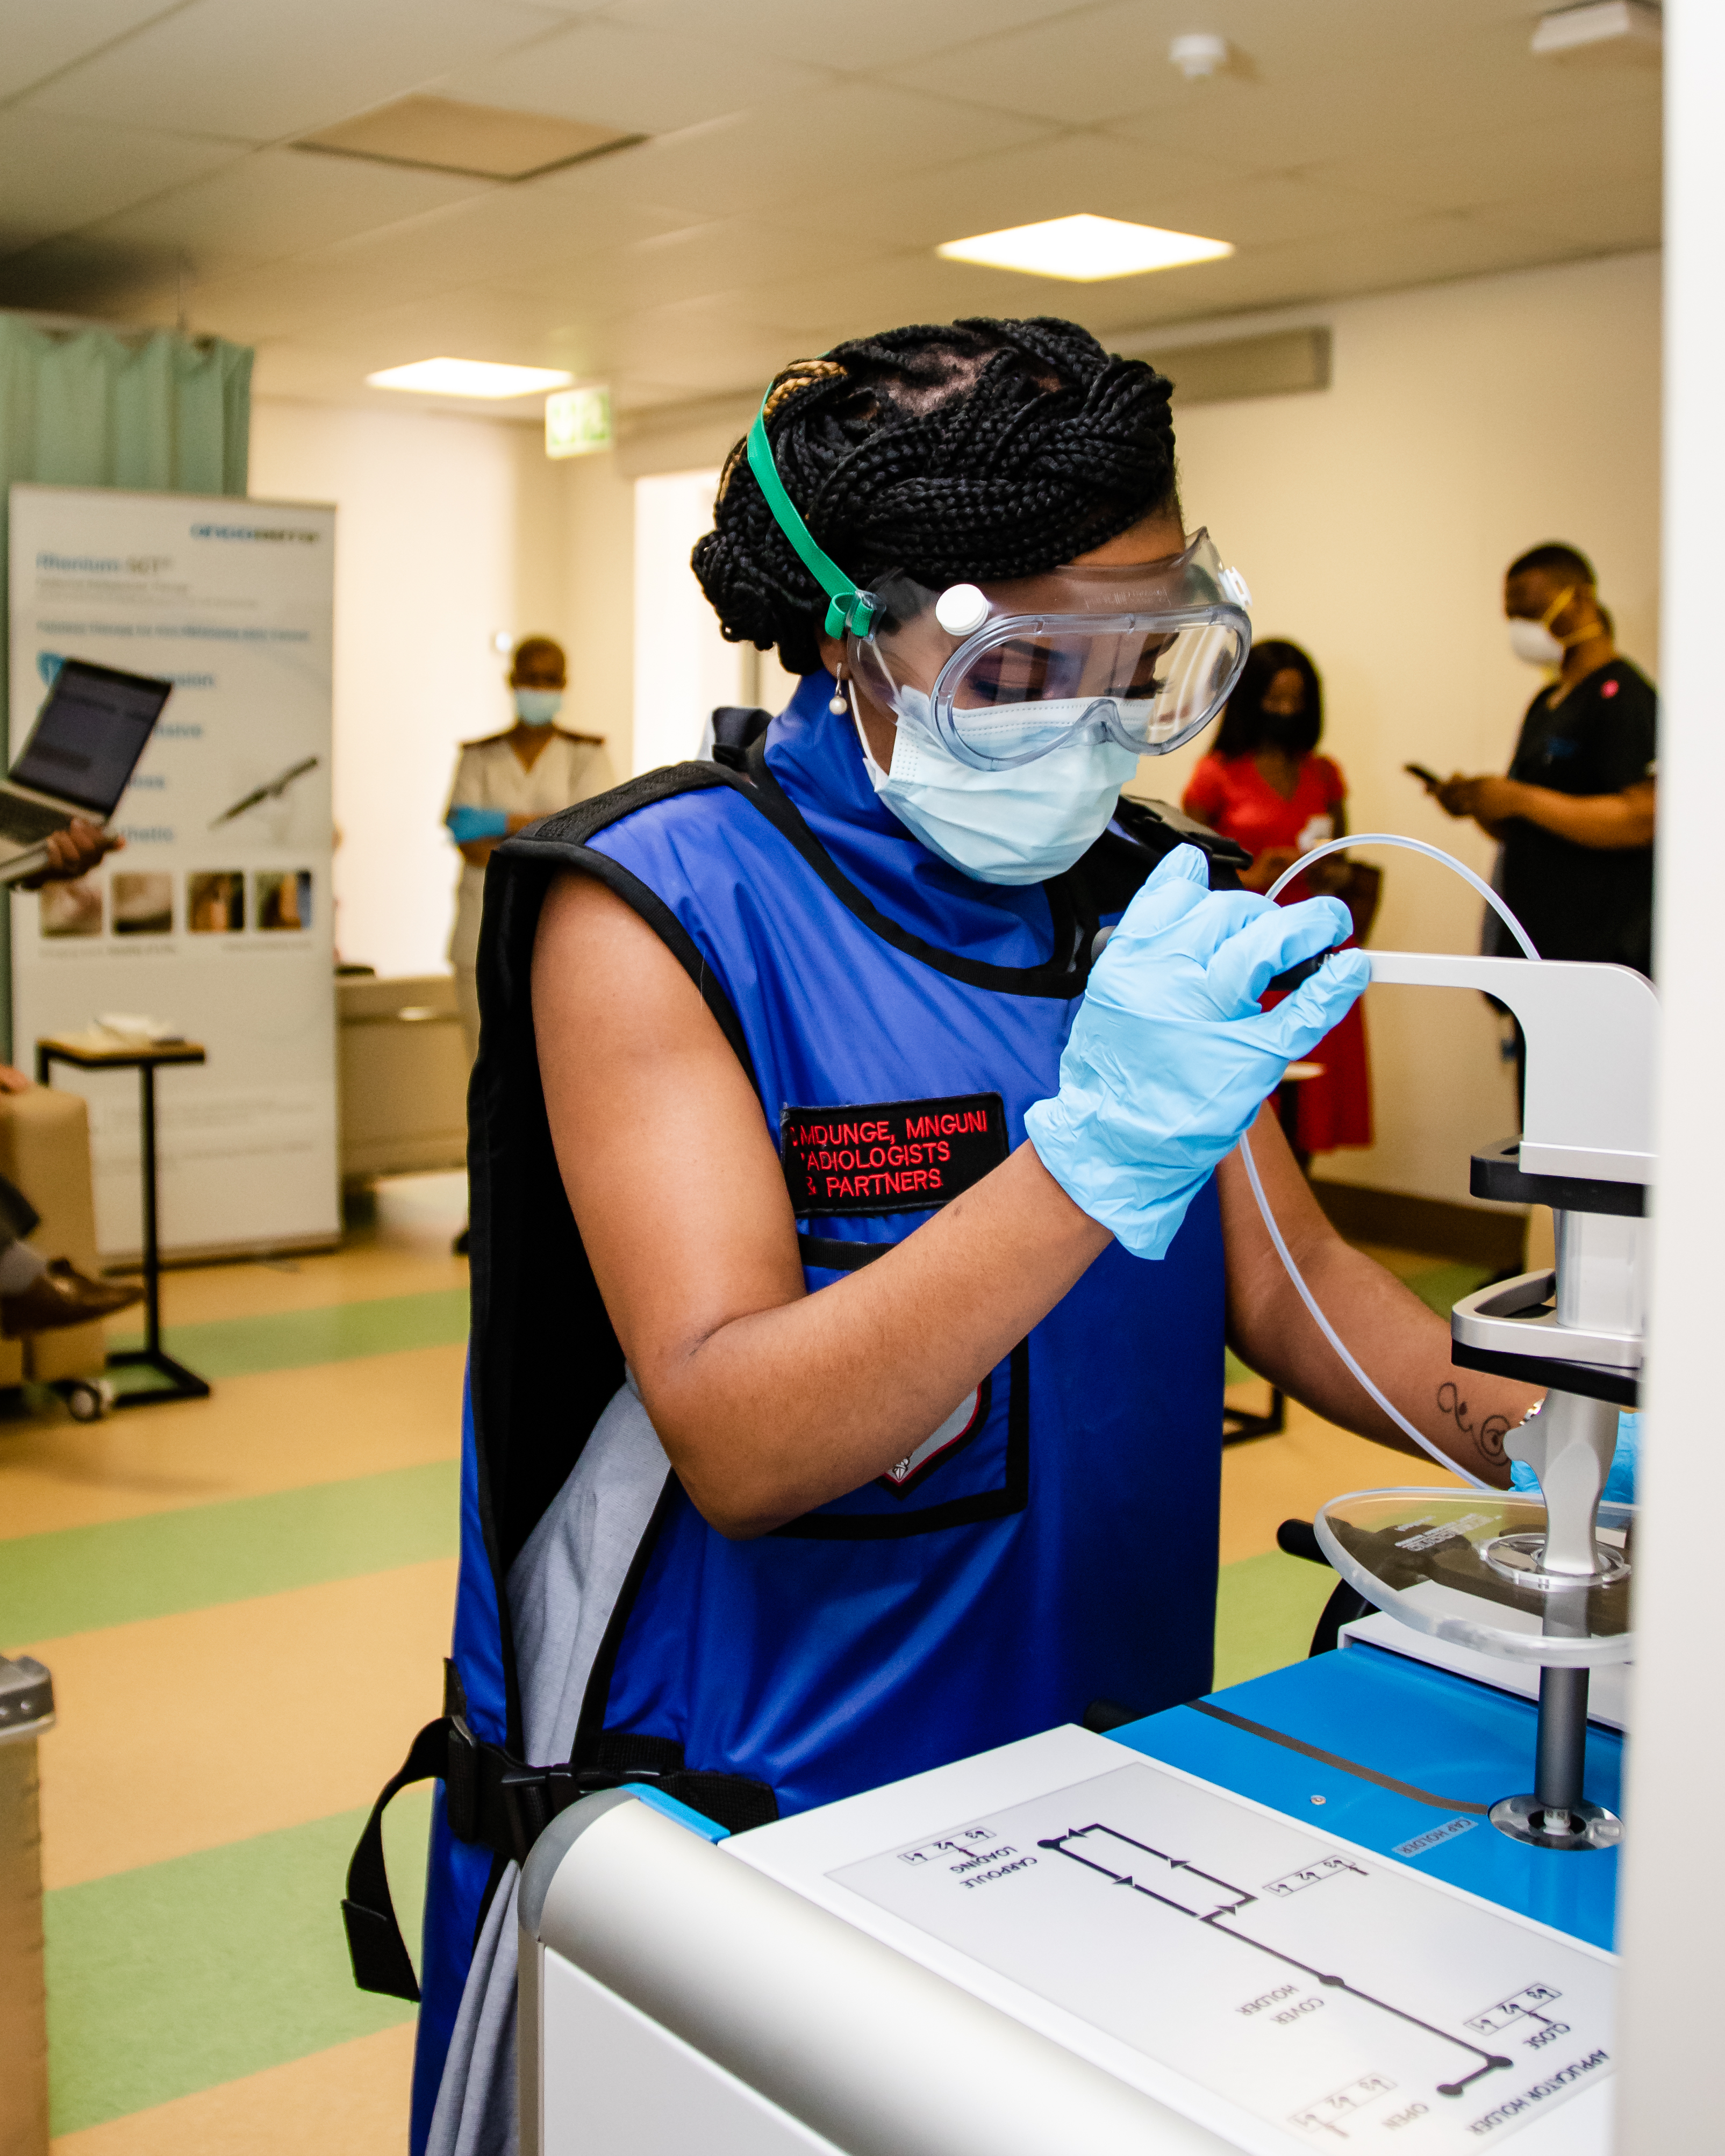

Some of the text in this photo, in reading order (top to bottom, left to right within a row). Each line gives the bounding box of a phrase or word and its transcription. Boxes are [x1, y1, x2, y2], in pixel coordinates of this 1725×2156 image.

[905, 1110, 988, 1140] MNGUNI
[800, 1141, 950, 1171] ADIOLOGISTS
[826, 1169, 943, 1198] PARTNERS
[1398, 1830, 1449, 1854] HOLDER
[949, 1846, 1018, 1875] LOADING
[959, 1856, 1038, 1889] CARPOULE
[1235, 1985, 1300, 2017] HOLDER
[1269, 1997, 1325, 2026] COVER
[1522, 2023, 1571, 2051] CLOSE
[1465, 2049, 1611, 2136] APPLICATOR HOLDER
[1381, 2103, 1430, 2131] OPEN
